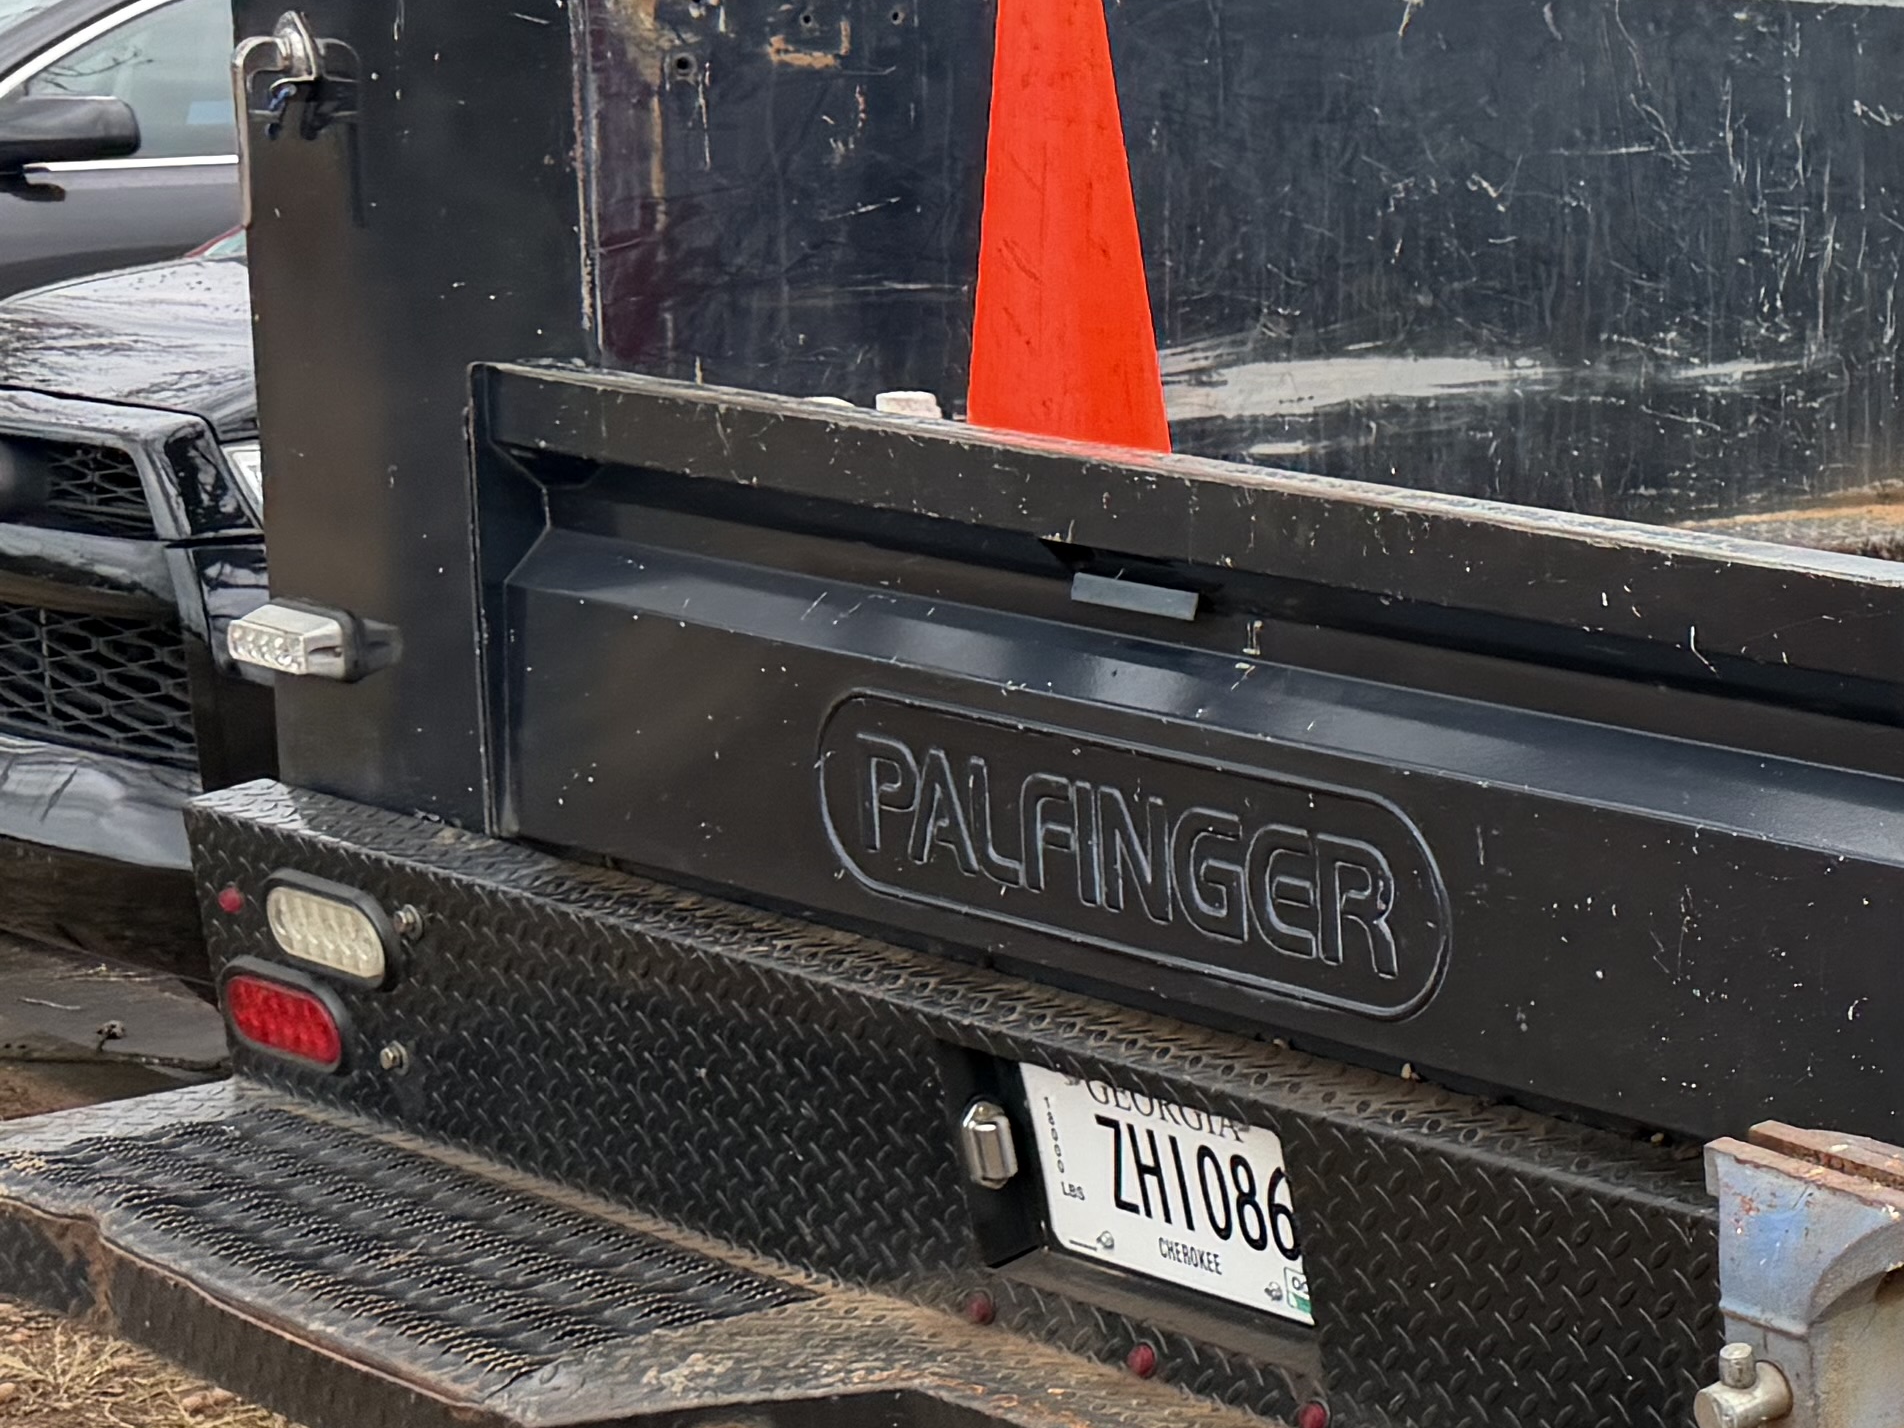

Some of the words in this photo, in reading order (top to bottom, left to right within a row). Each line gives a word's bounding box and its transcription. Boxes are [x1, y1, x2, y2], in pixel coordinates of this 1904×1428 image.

[855, 732, 1398, 979] PALFINGER
[1060, 1181, 1086, 1201] LBS
[1158, 1236, 1223, 1276] CHEROKEE
